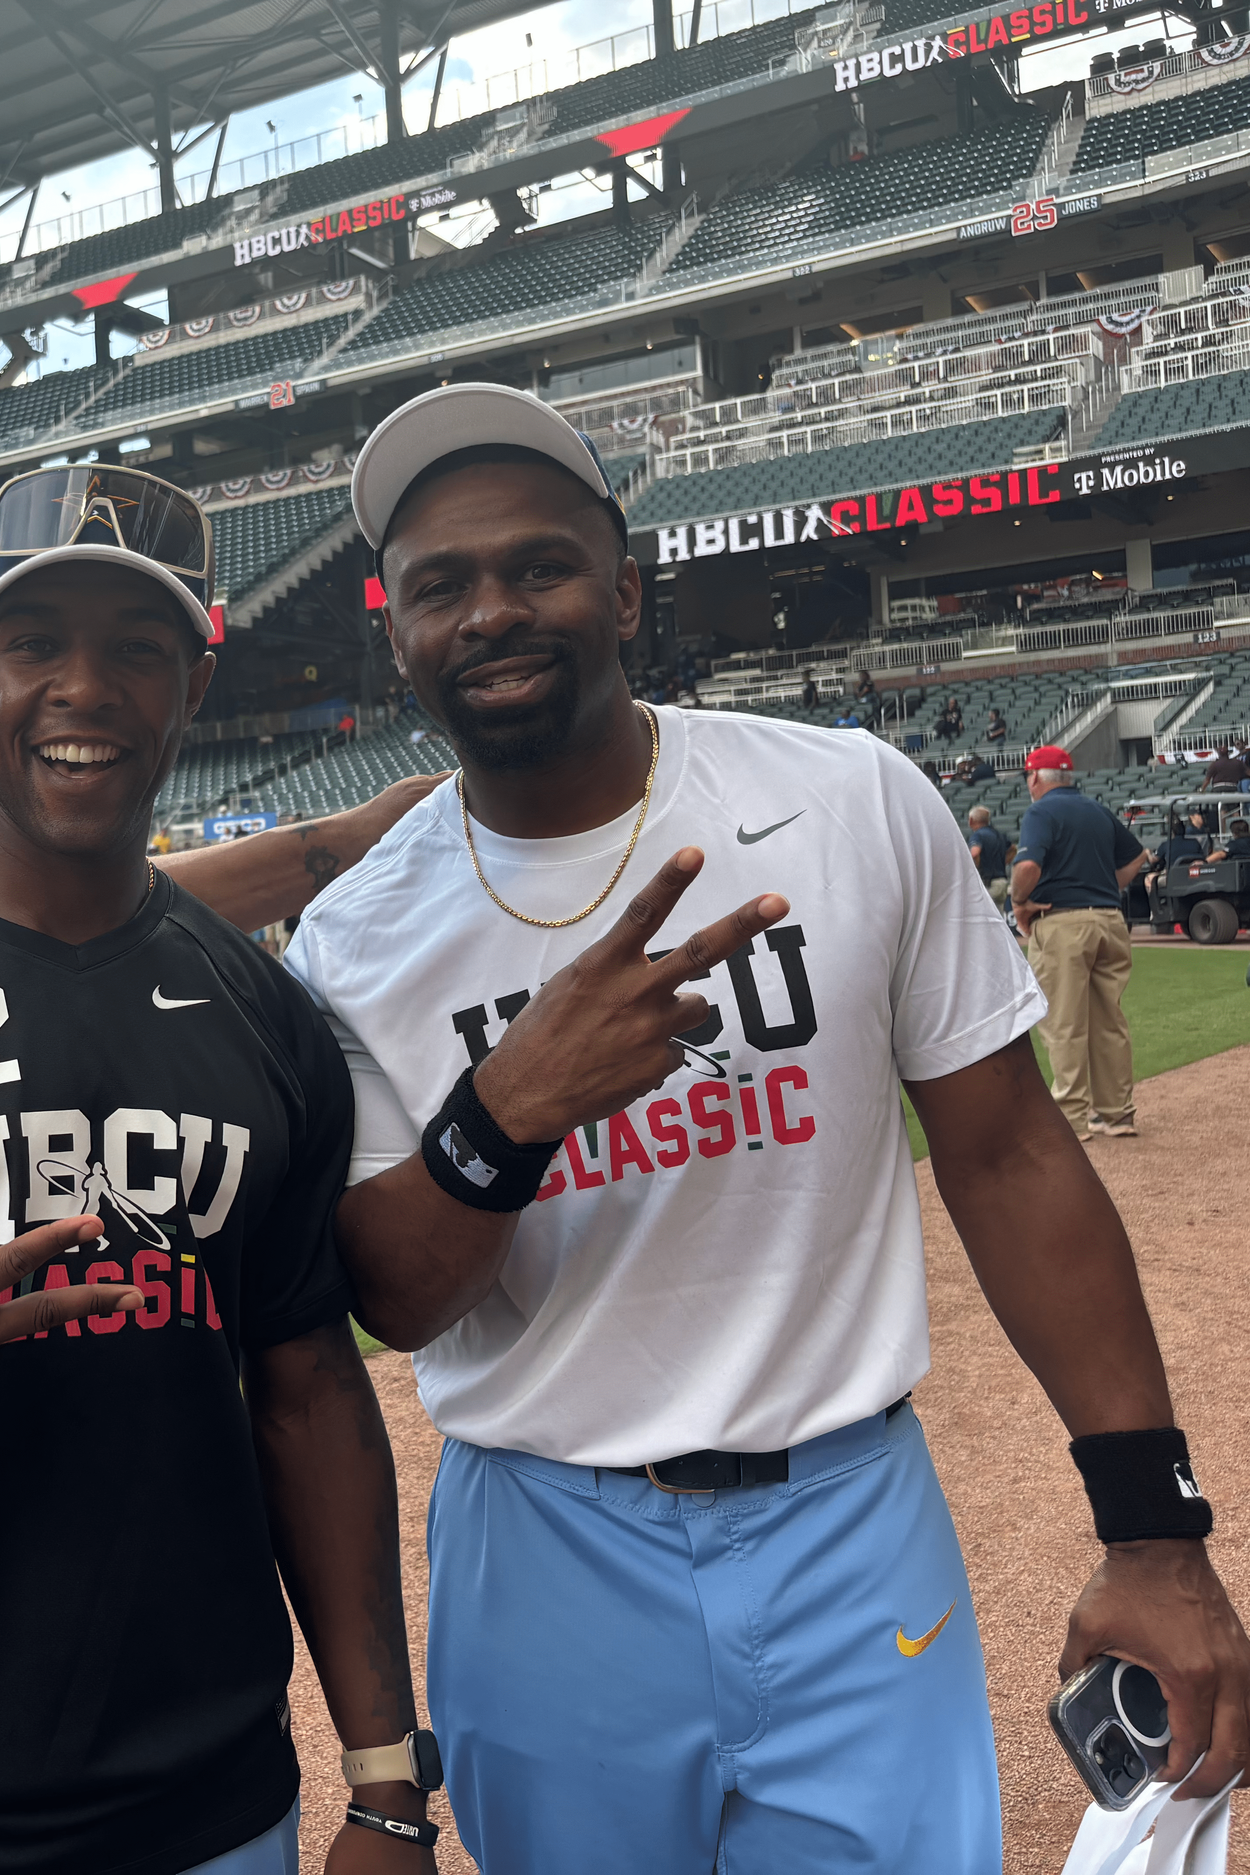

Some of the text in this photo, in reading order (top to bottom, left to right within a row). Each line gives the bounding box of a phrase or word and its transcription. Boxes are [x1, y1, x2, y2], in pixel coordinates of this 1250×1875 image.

[833, 36, 927, 92] HBCU
[1188, 171, 1206, 183] 323
[959, 195, 1098, 239] ANDRUW 25 JONES
[233, 226, 300, 267] HBCU
[794, 265, 810, 277] 322
[270, 380, 295, 410] 21
[1145, 447, 1155, 456] BY
[657, 507, 797, 565] HBCU
[830, 464, 1060, 537] CLASSIC
[1100, 456, 1186, 491] Mobile
[1197, 630, 1217, 644] 123
